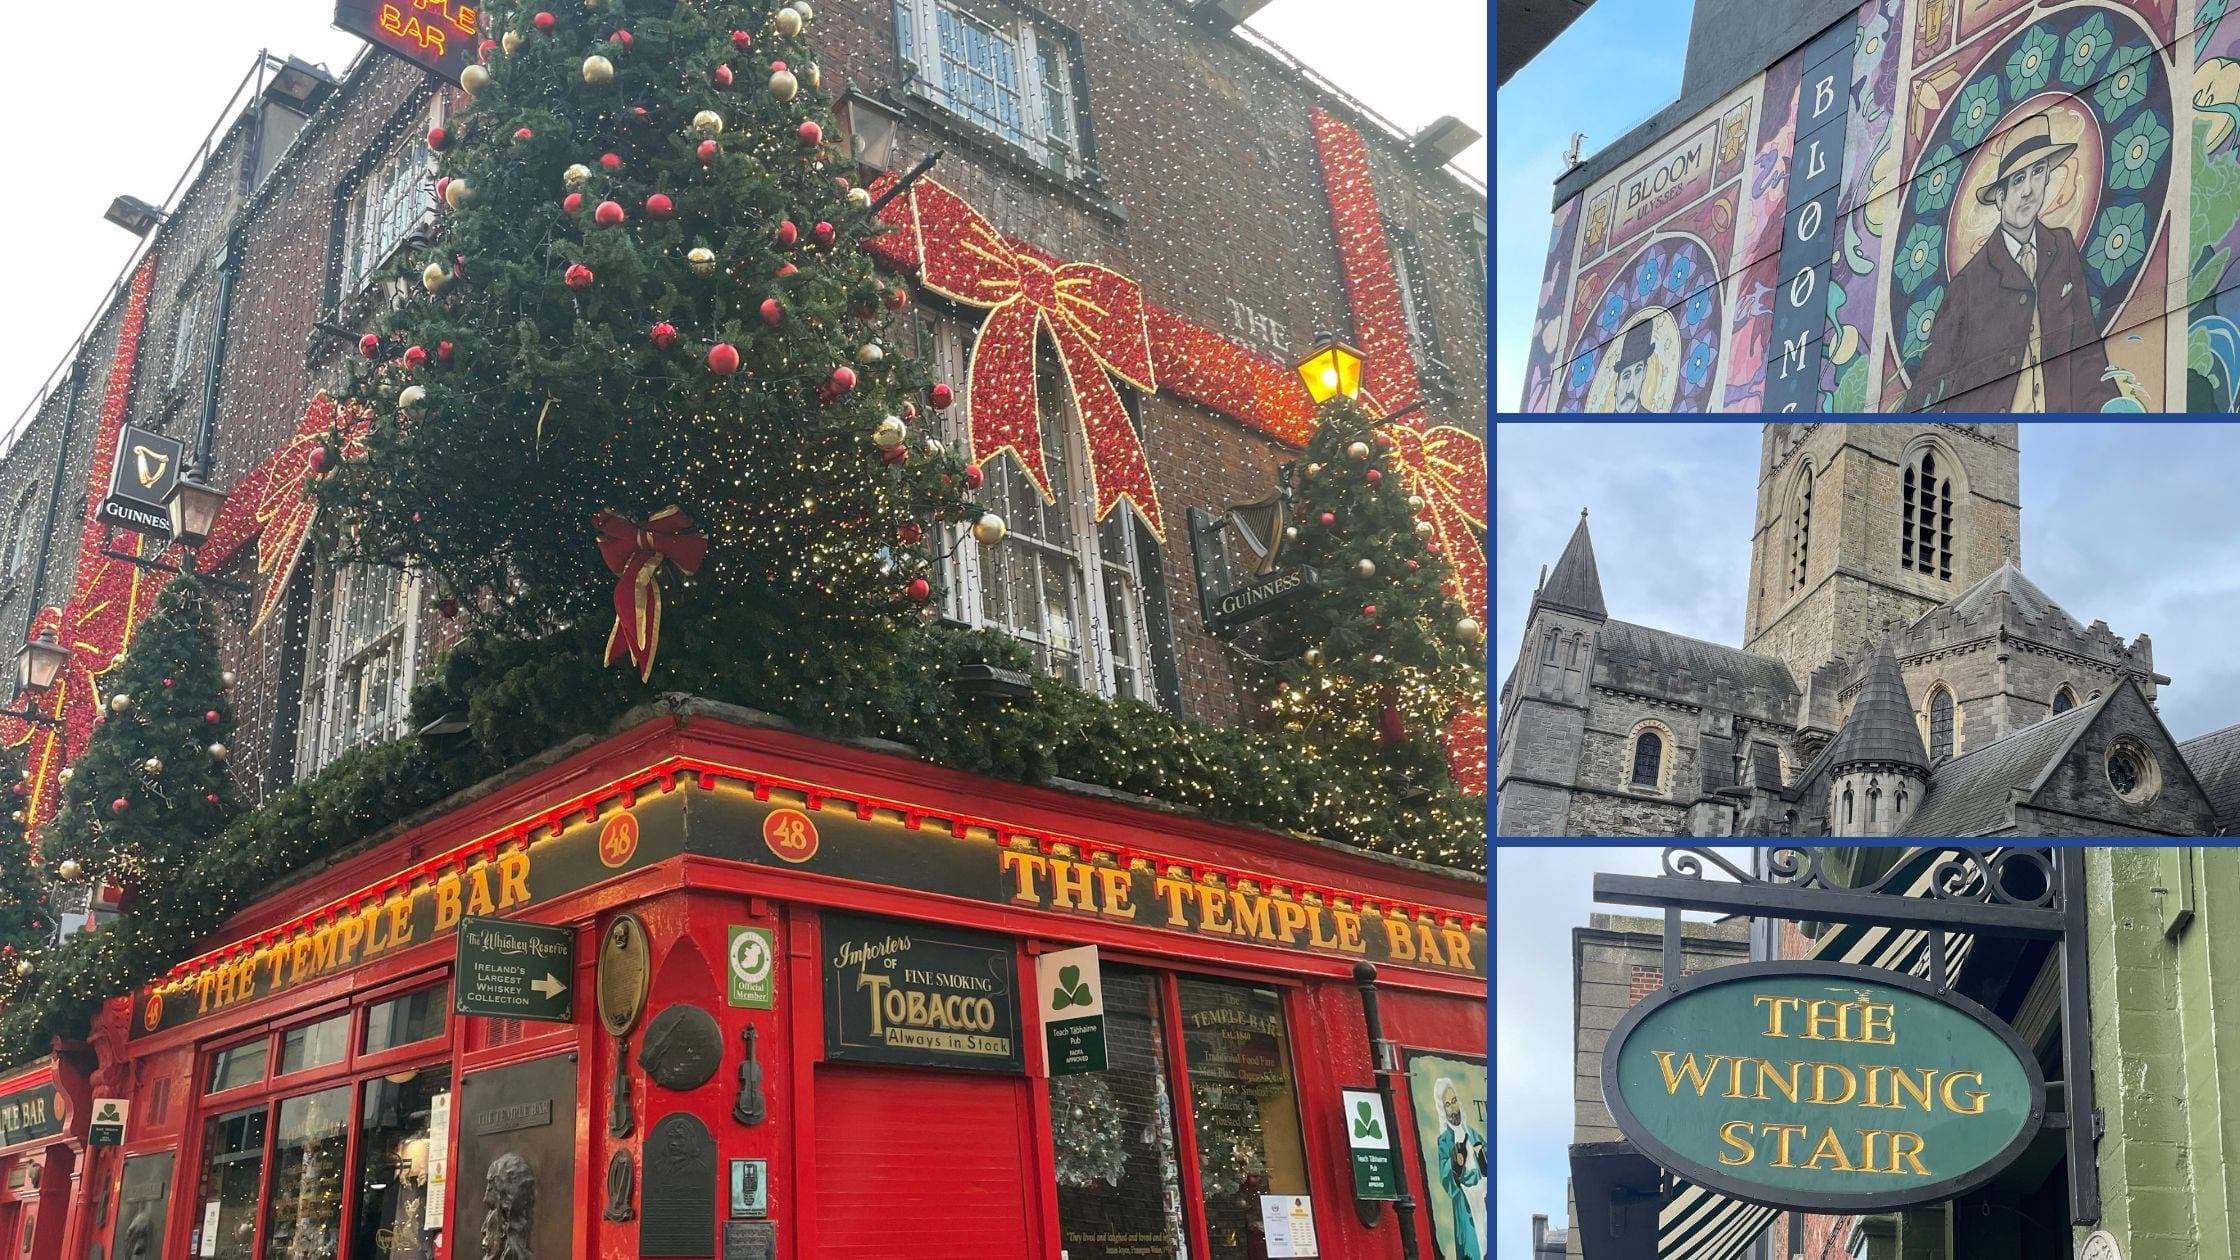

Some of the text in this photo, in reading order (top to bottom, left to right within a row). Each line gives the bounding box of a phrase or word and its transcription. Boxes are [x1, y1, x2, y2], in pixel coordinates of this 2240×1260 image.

[380, 4, 445, 55] BAR
[1626, 143, 1702, 211] BLOOM
[1637, 183, 1684, 221] ULYSSES
[1226, 296, 1289, 352] THE
[1222, 571, 1301, 614] GUINNESS
[604, 822, 631, 858] 48
[773, 816, 807, 849] 48
[1002, 851, 1476, 970] THE TEMPLE BAR
[198, 852, 532, 1014] THE TEMPLE BAR
[466, 929, 568, 958] The Whiskey Reserve
[474, 962, 526, 975] IRELAND'S
[834, 935, 911, 985] Importers
[884, 958, 898, 969] OF
[475, 983, 522, 994] WHISKEY
[477, 973, 521, 984] LARGEST
[738, 982, 764, 992] Official
[904, 969, 992, 992] FINE SMOKING
[466, 992, 529, 1005] COLLECTION
[736, 990, 767, 1001] Member
[859, 973, 995, 1036] TOBACCO
[1191, 1008, 1246, 1029] TEMPLE
[1753, 994, 1896, 1045] THE
[888, 1028, 1008, 1053] Always in Stock
[1070, 1036, 1081, 1045] Pub
[1651, 1050, 1991, 1115] WINDING
[22, 1098, 46, 1127] BAR
[1718, 1120, 1932, 1176] STAIR
